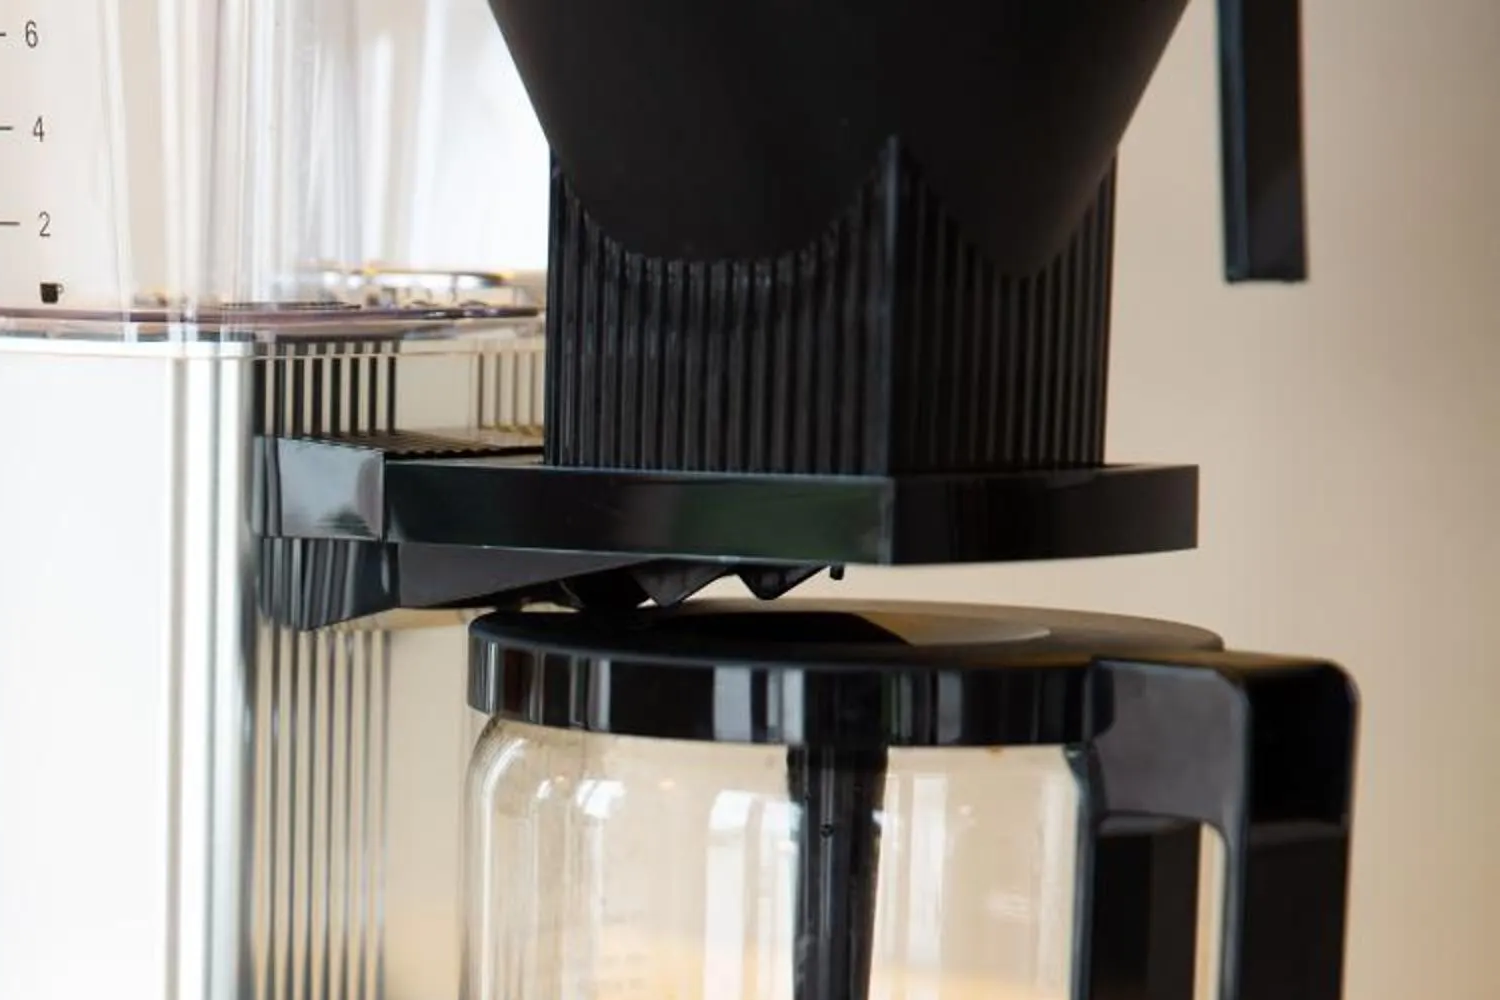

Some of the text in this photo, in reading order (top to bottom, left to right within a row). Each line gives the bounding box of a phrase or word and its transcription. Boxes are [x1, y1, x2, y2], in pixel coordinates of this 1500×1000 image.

[24, 20, 39, 48] 6
[32, 115, 45, 142] 4
[38, 211, 51, 237] 2
